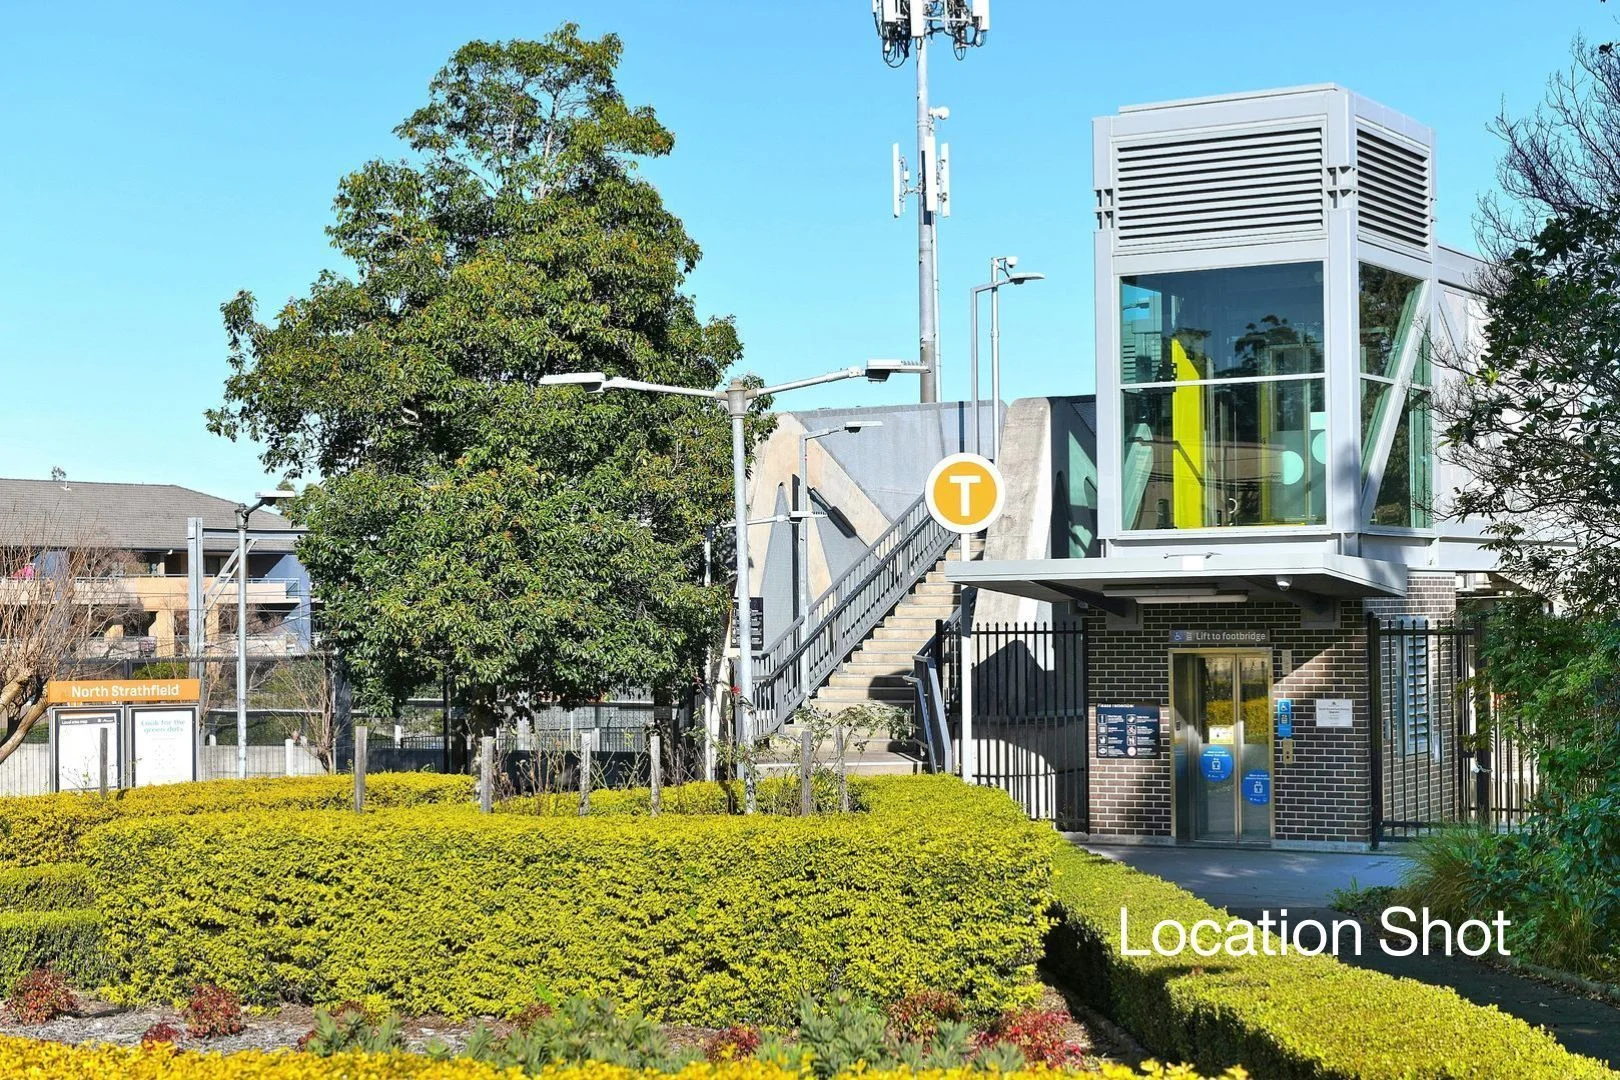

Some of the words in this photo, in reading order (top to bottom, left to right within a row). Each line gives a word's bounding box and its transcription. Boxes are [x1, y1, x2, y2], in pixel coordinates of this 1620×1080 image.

[949, 475, 982, 517] T
[1196, 632, 1211, 640] Lift
[1212, 632, 1221, 640] to
[1222, 632, 1266, 642] footbridge
[71, 685, 109, 698] North
[111, 684, 180, 697] Strathfield
